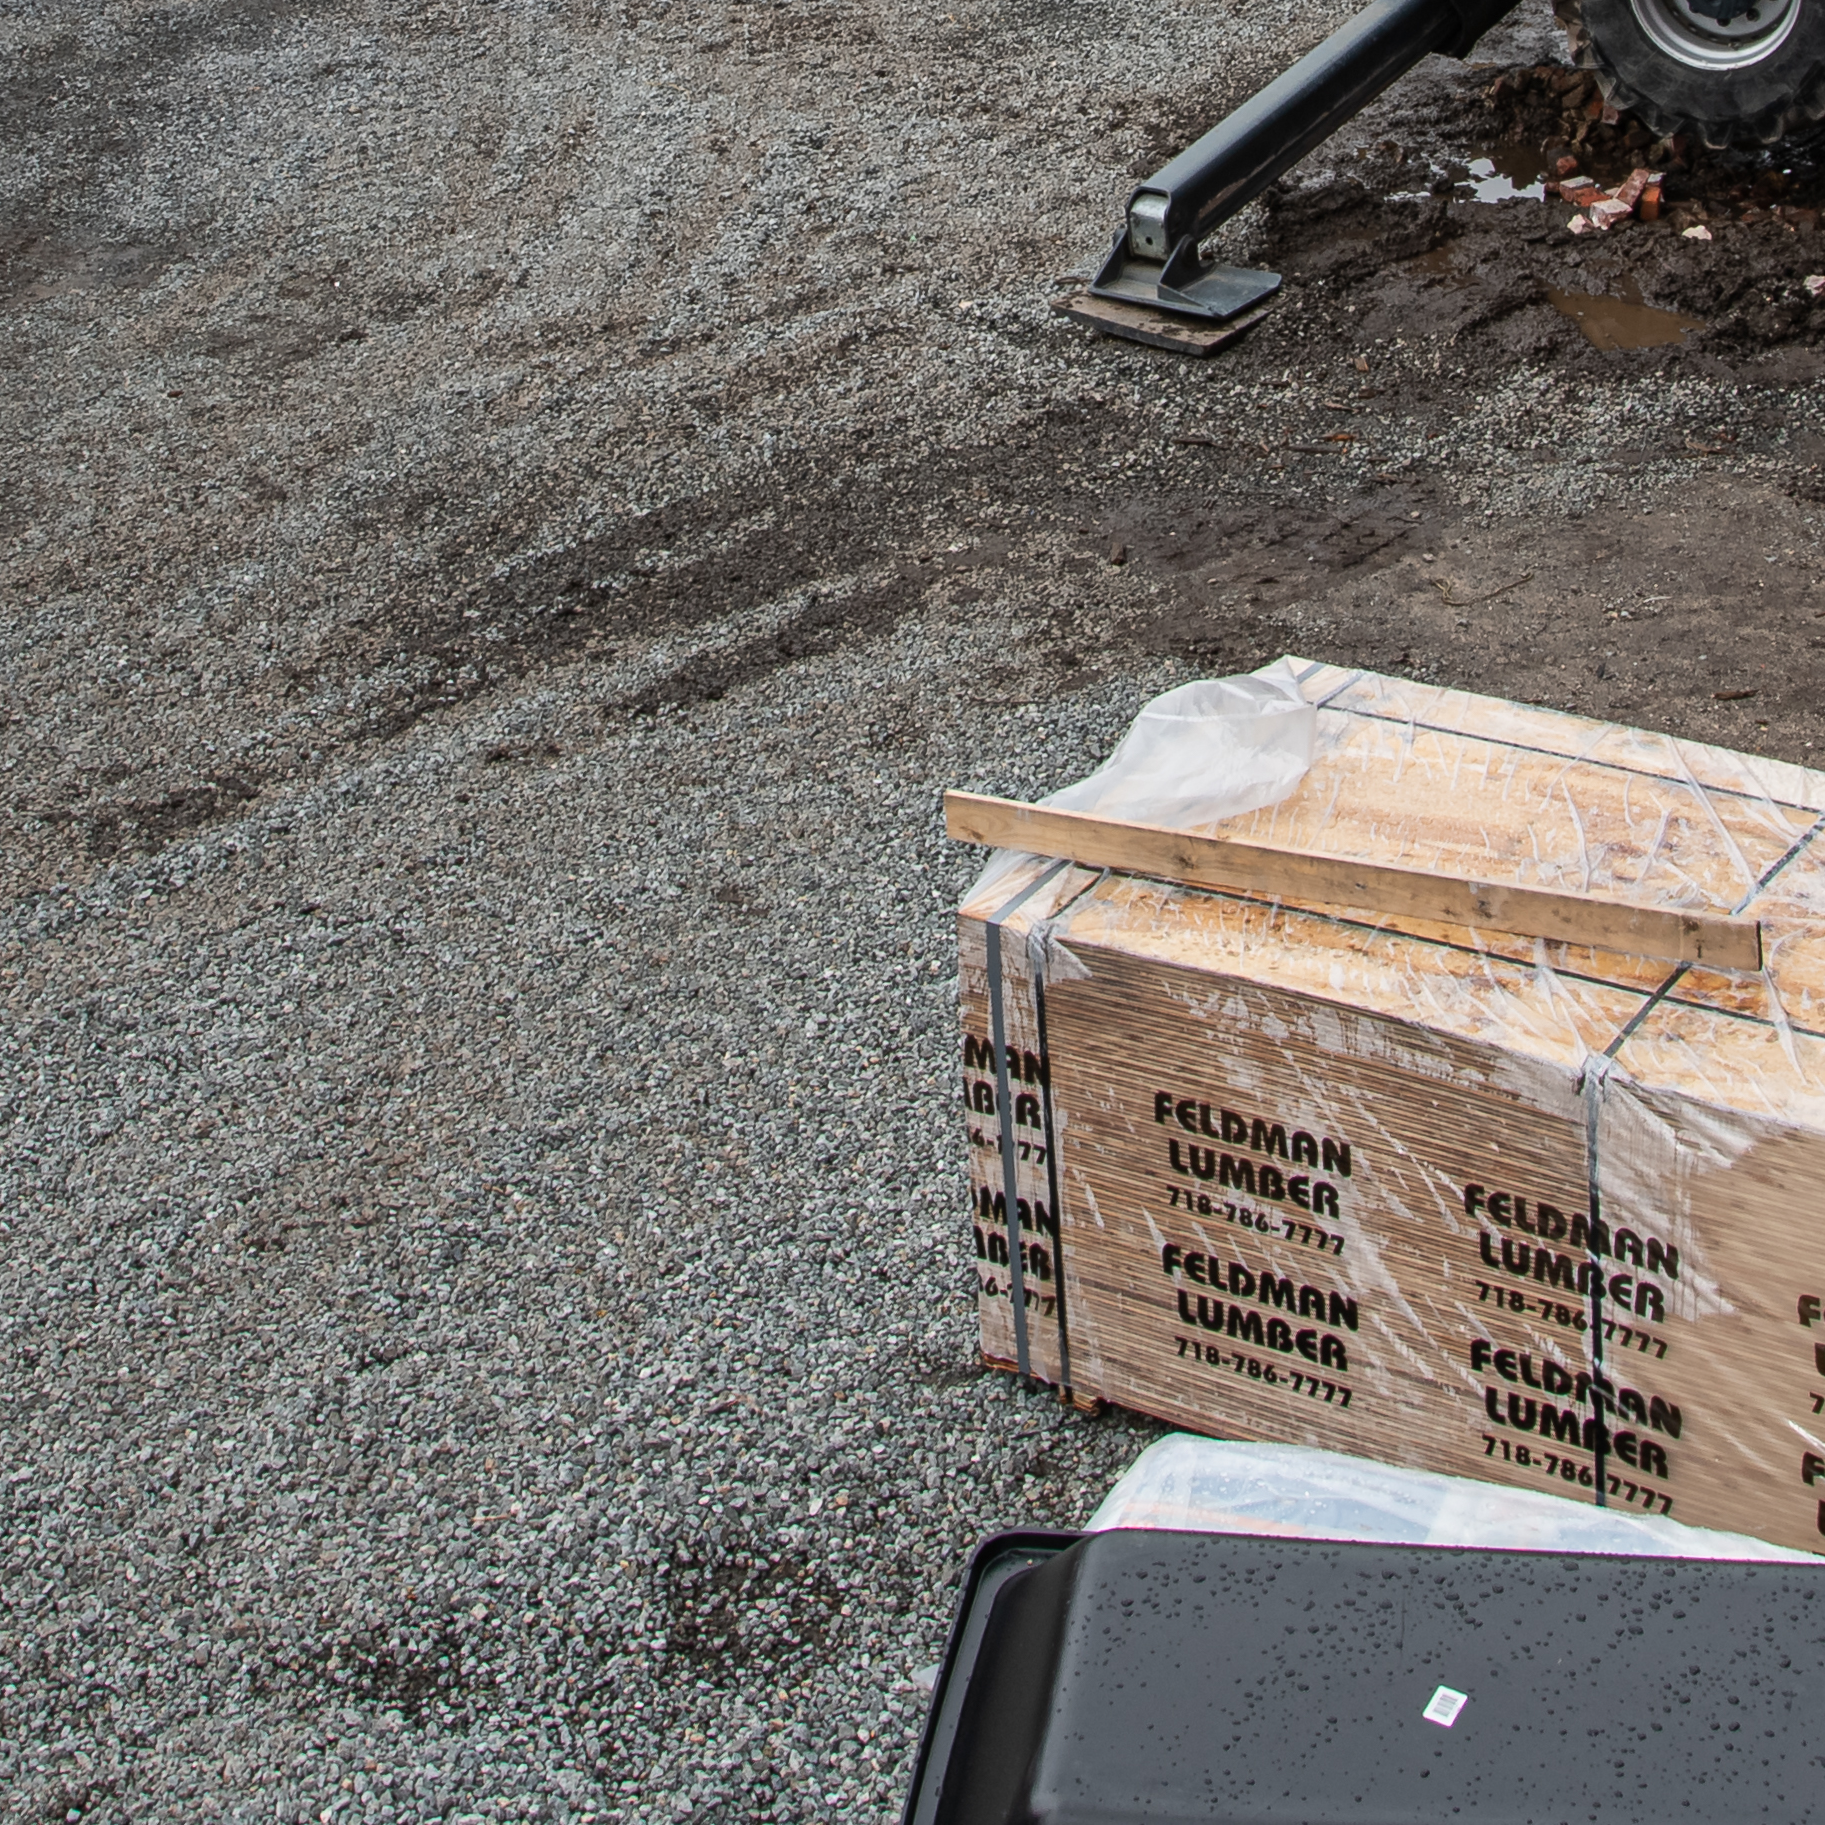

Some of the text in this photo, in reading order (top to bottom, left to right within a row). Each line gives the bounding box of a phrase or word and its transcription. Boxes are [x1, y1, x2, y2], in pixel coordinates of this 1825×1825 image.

[1154, 1090, 1352, 1178] FELDMAN
[1168, 1137, 1340, 1220] LUMBER
[1166, 1184, 1346, 1257] 718-786-7777
[1463, 1182, 1679, 1280] FELDMAN
[1162, 1241, 1360, 1333] FELDMAN
[1479, 1230, 1665, 1324] LUMBER
[1174, 1335, 1353, 1409] 718-786-7777
[1177, 1288, 1349, 1373] LUMBER
[1470, 1338, 1683, 1440] FELDMAN
[1485, 1385, 1669, 1480] LUMBER
